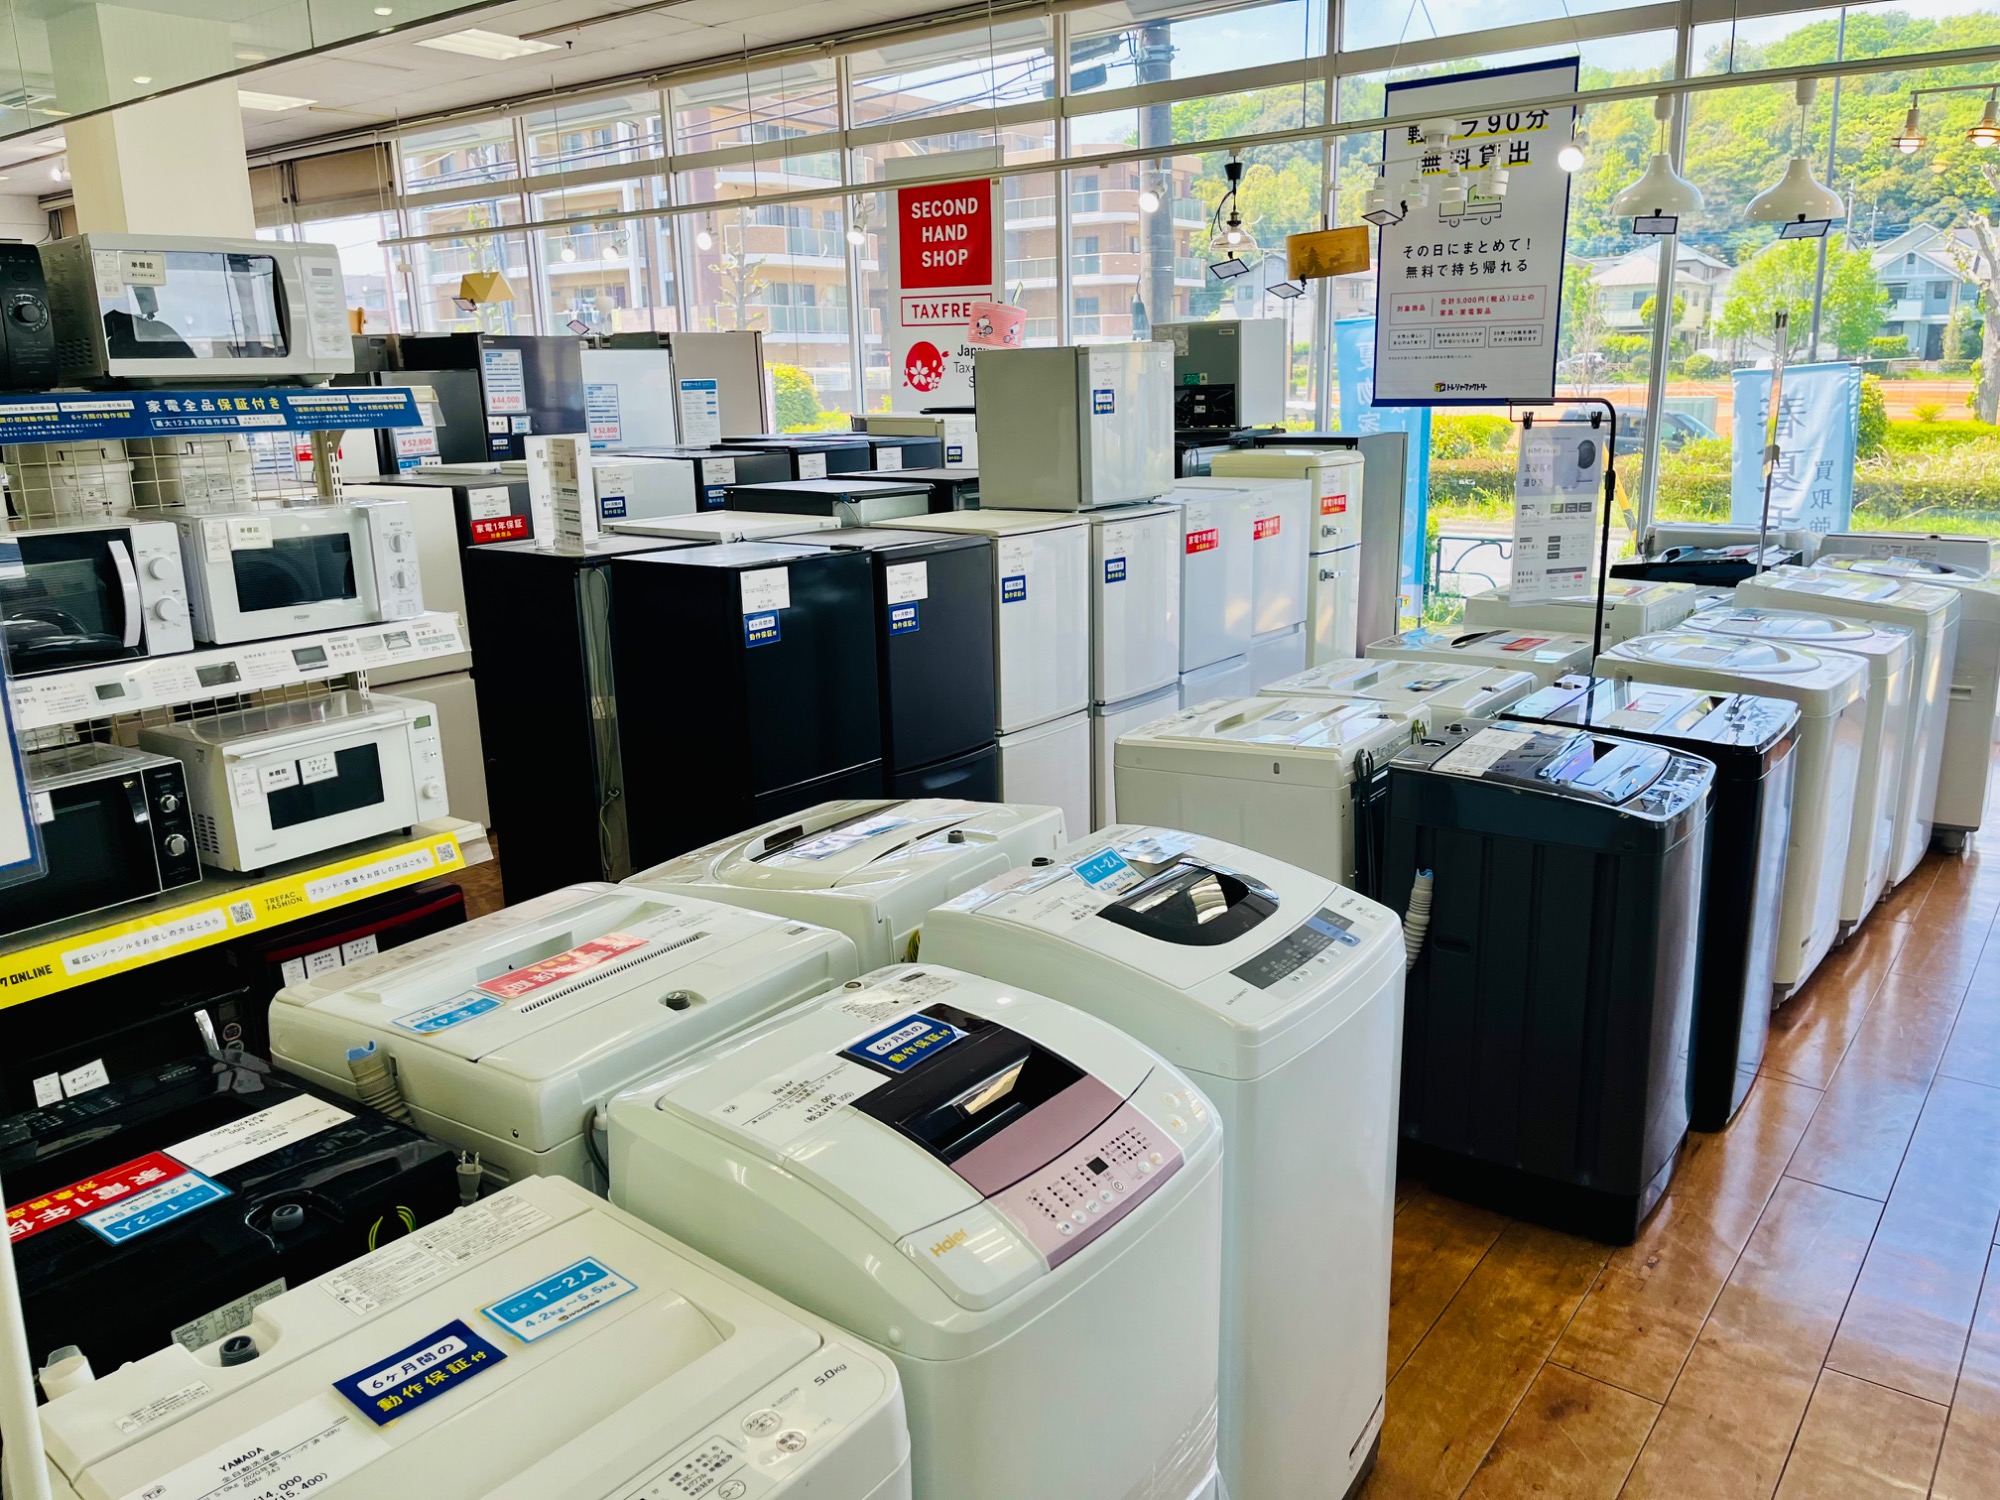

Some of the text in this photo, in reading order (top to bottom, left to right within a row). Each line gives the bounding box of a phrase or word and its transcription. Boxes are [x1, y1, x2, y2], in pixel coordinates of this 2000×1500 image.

[911, 197, 979, 219] SECOND
[922, 224, 968, 243] HAND
[131, 261, 153, 269] 単機能
[921, 248, 969, 268] SHOP
[1406, 259, 1528, 279] 無料で持ち帰れる
[912, 302, 971, 319] TAXFRE
[145, 397, 280, 413] 家電全品保証付き
[491, 396, 520, 404] ¥44,000
[401, 437, 432, 448] ¥52,800
[475, 519, 523, 534] 家電1年保証
[307, 757, 328, 767] フラット
[311, 764, 327, 772] タイプ
[269, 768, 287, 777] 単機能
[310, 856, 429, 896] ブランド・古着をお探しの方はこちら
[264, 891, 296, 905] TREFAC
[266, 896, 303, 912] FASHION
[72, 917, 219, 966] 幅広いジャンルをお探しの方はこちら
[353, 946, 369, 955] タイプ
[10, 964, 53, 986] ONLINE
[888, 1027, 951, 1063] 動作保証付
[771, 1080, 794, 1096] Haier
[929, 1228, 968, 1258] Haier
[376, 1350, 488, 1413] 動作保証付
[218, 1446, 265, 1473] YAMADA
[221, 1449, 281, 1484] 全自動洗濯機
